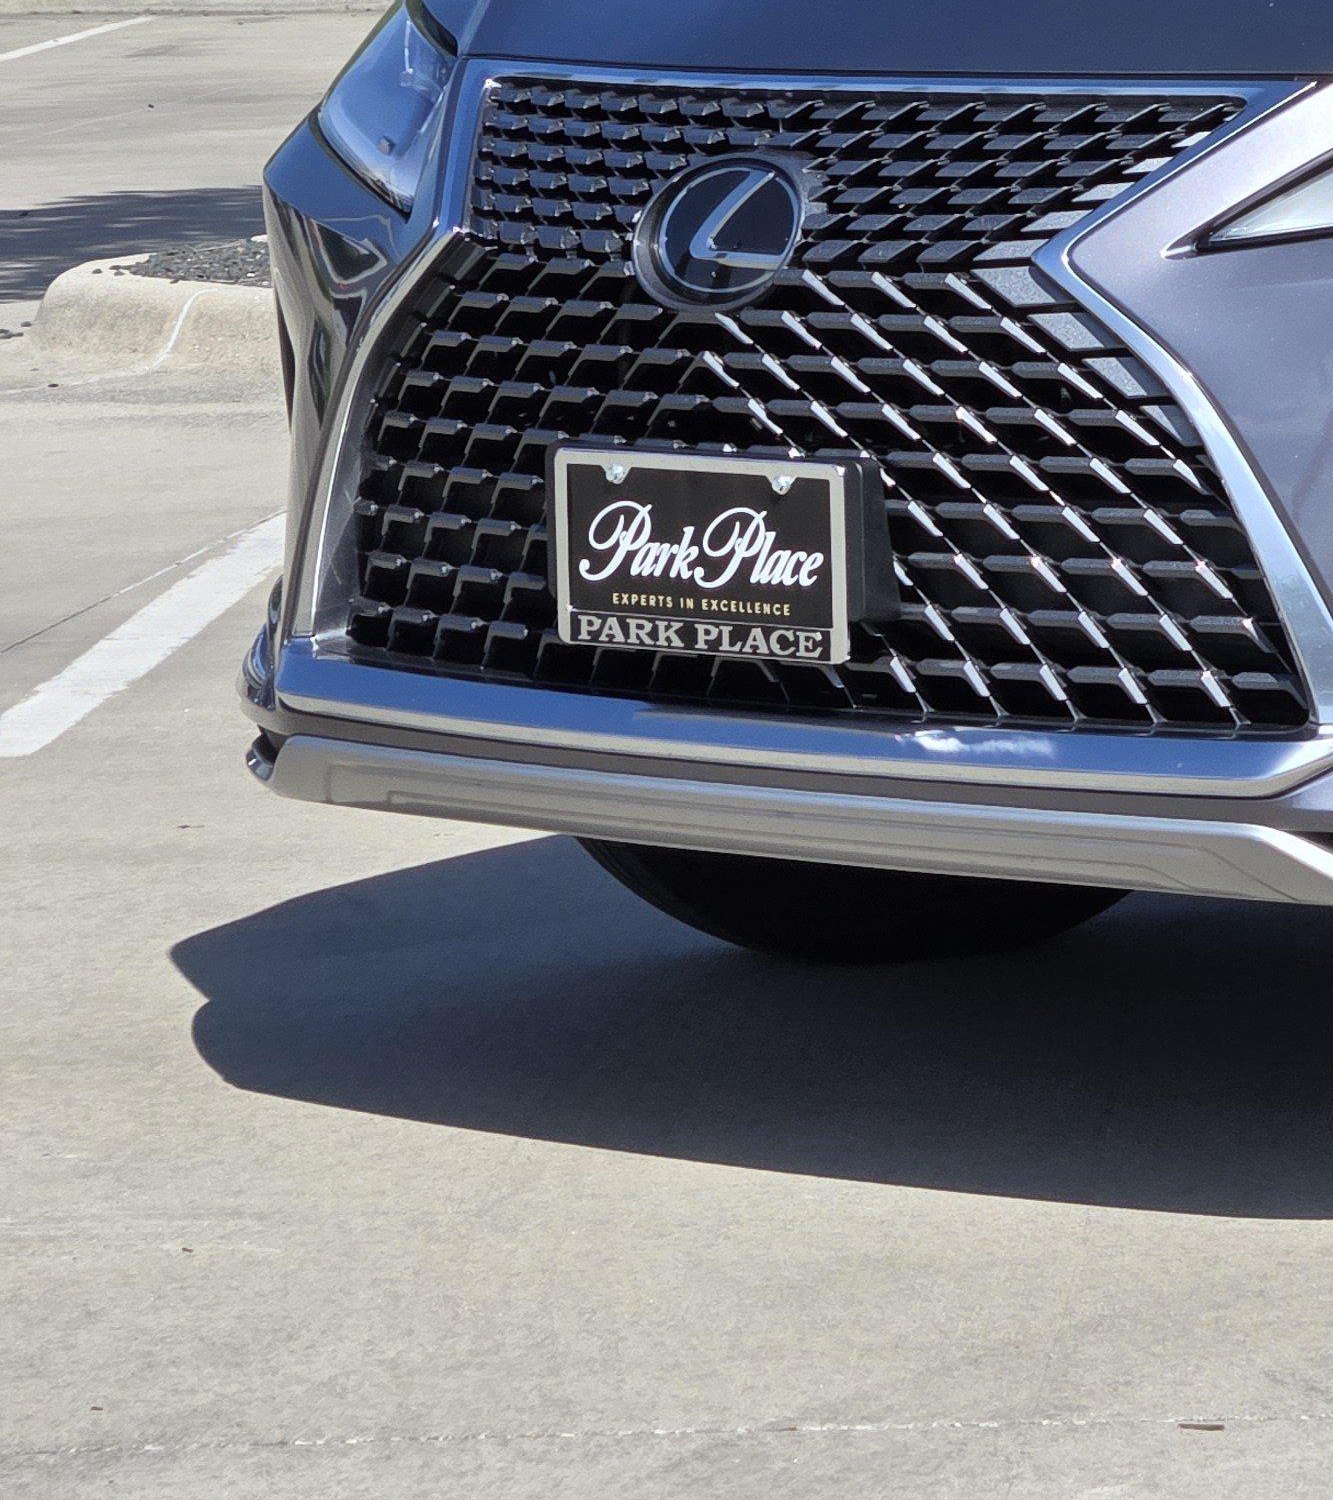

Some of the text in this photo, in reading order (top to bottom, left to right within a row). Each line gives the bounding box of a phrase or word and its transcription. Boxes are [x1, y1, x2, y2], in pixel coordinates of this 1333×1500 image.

[579, 500, 825, 588] Park Place
[612, 592, 791, 616] EXPERTS IN EXCELLENCE
[577, 614, 823, 658] PARK PLACE
